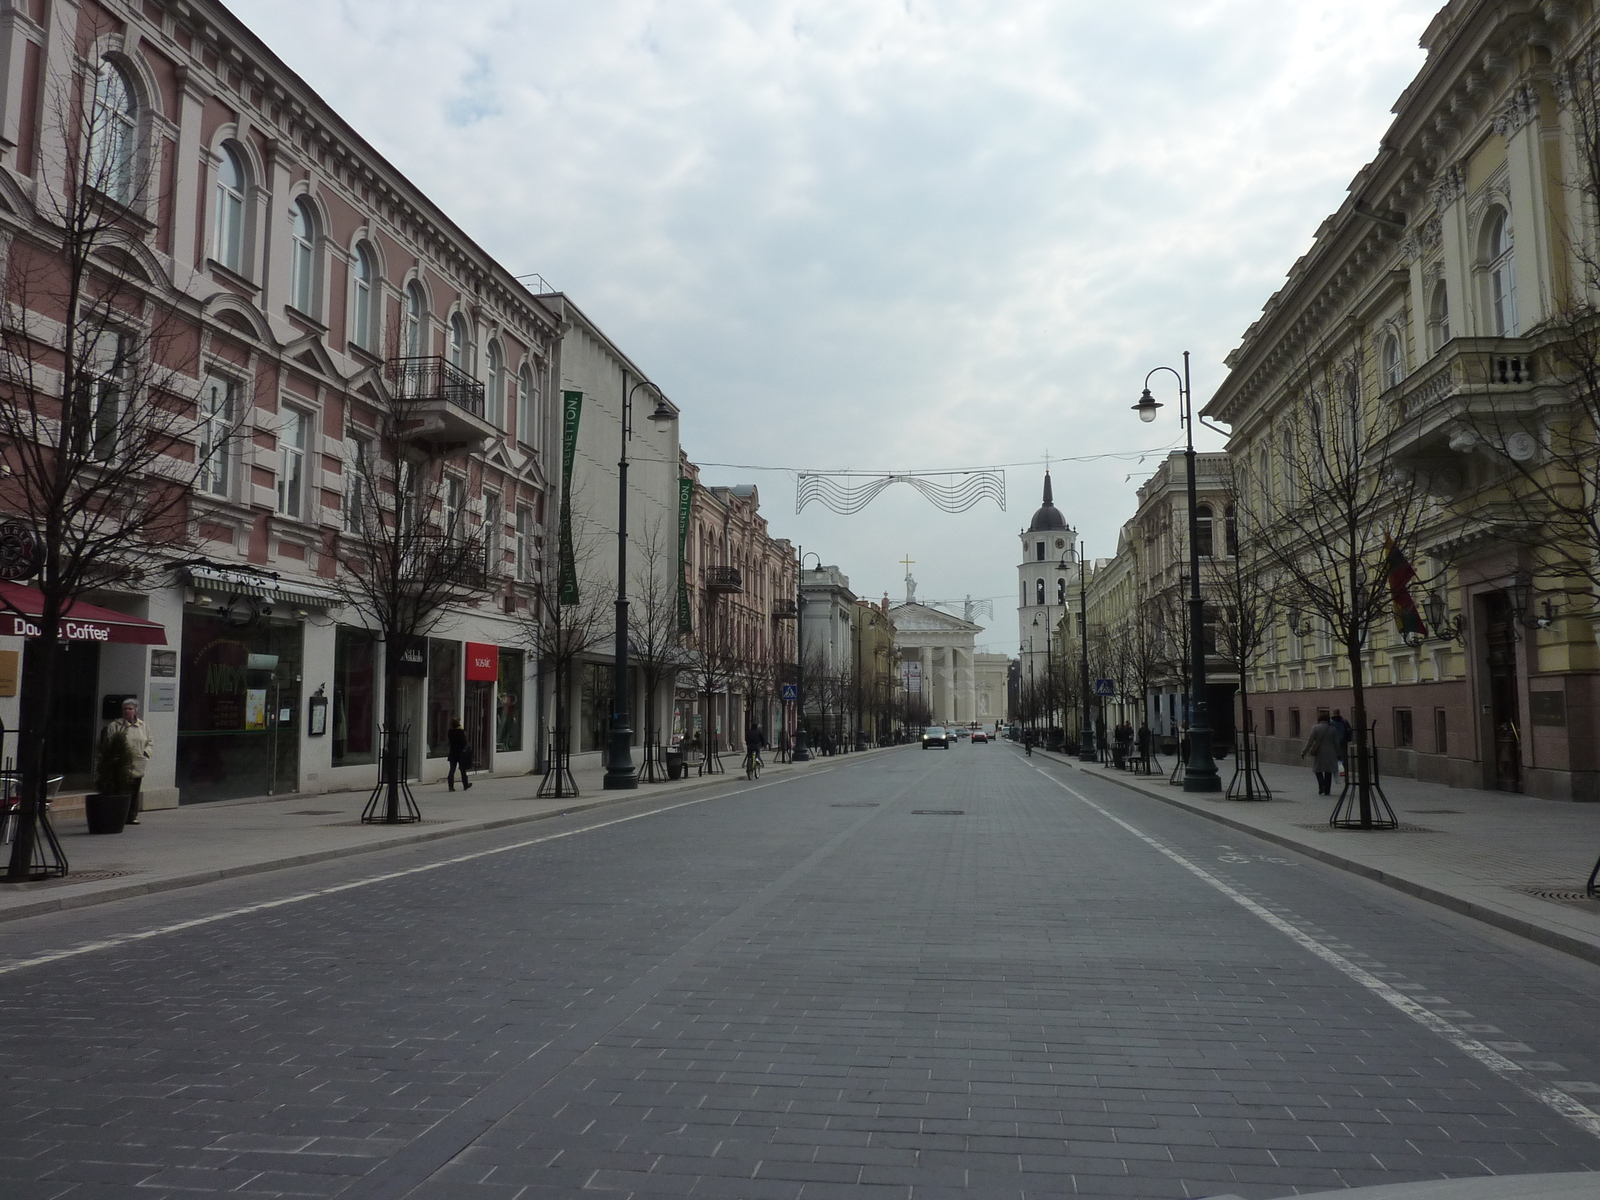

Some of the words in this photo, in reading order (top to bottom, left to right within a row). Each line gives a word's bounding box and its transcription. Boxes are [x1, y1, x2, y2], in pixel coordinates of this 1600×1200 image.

[562, 489, 570, 541] COLORS
[14, 617, 63, 638] Doue
[66, 622, 109, 641] Coffee
